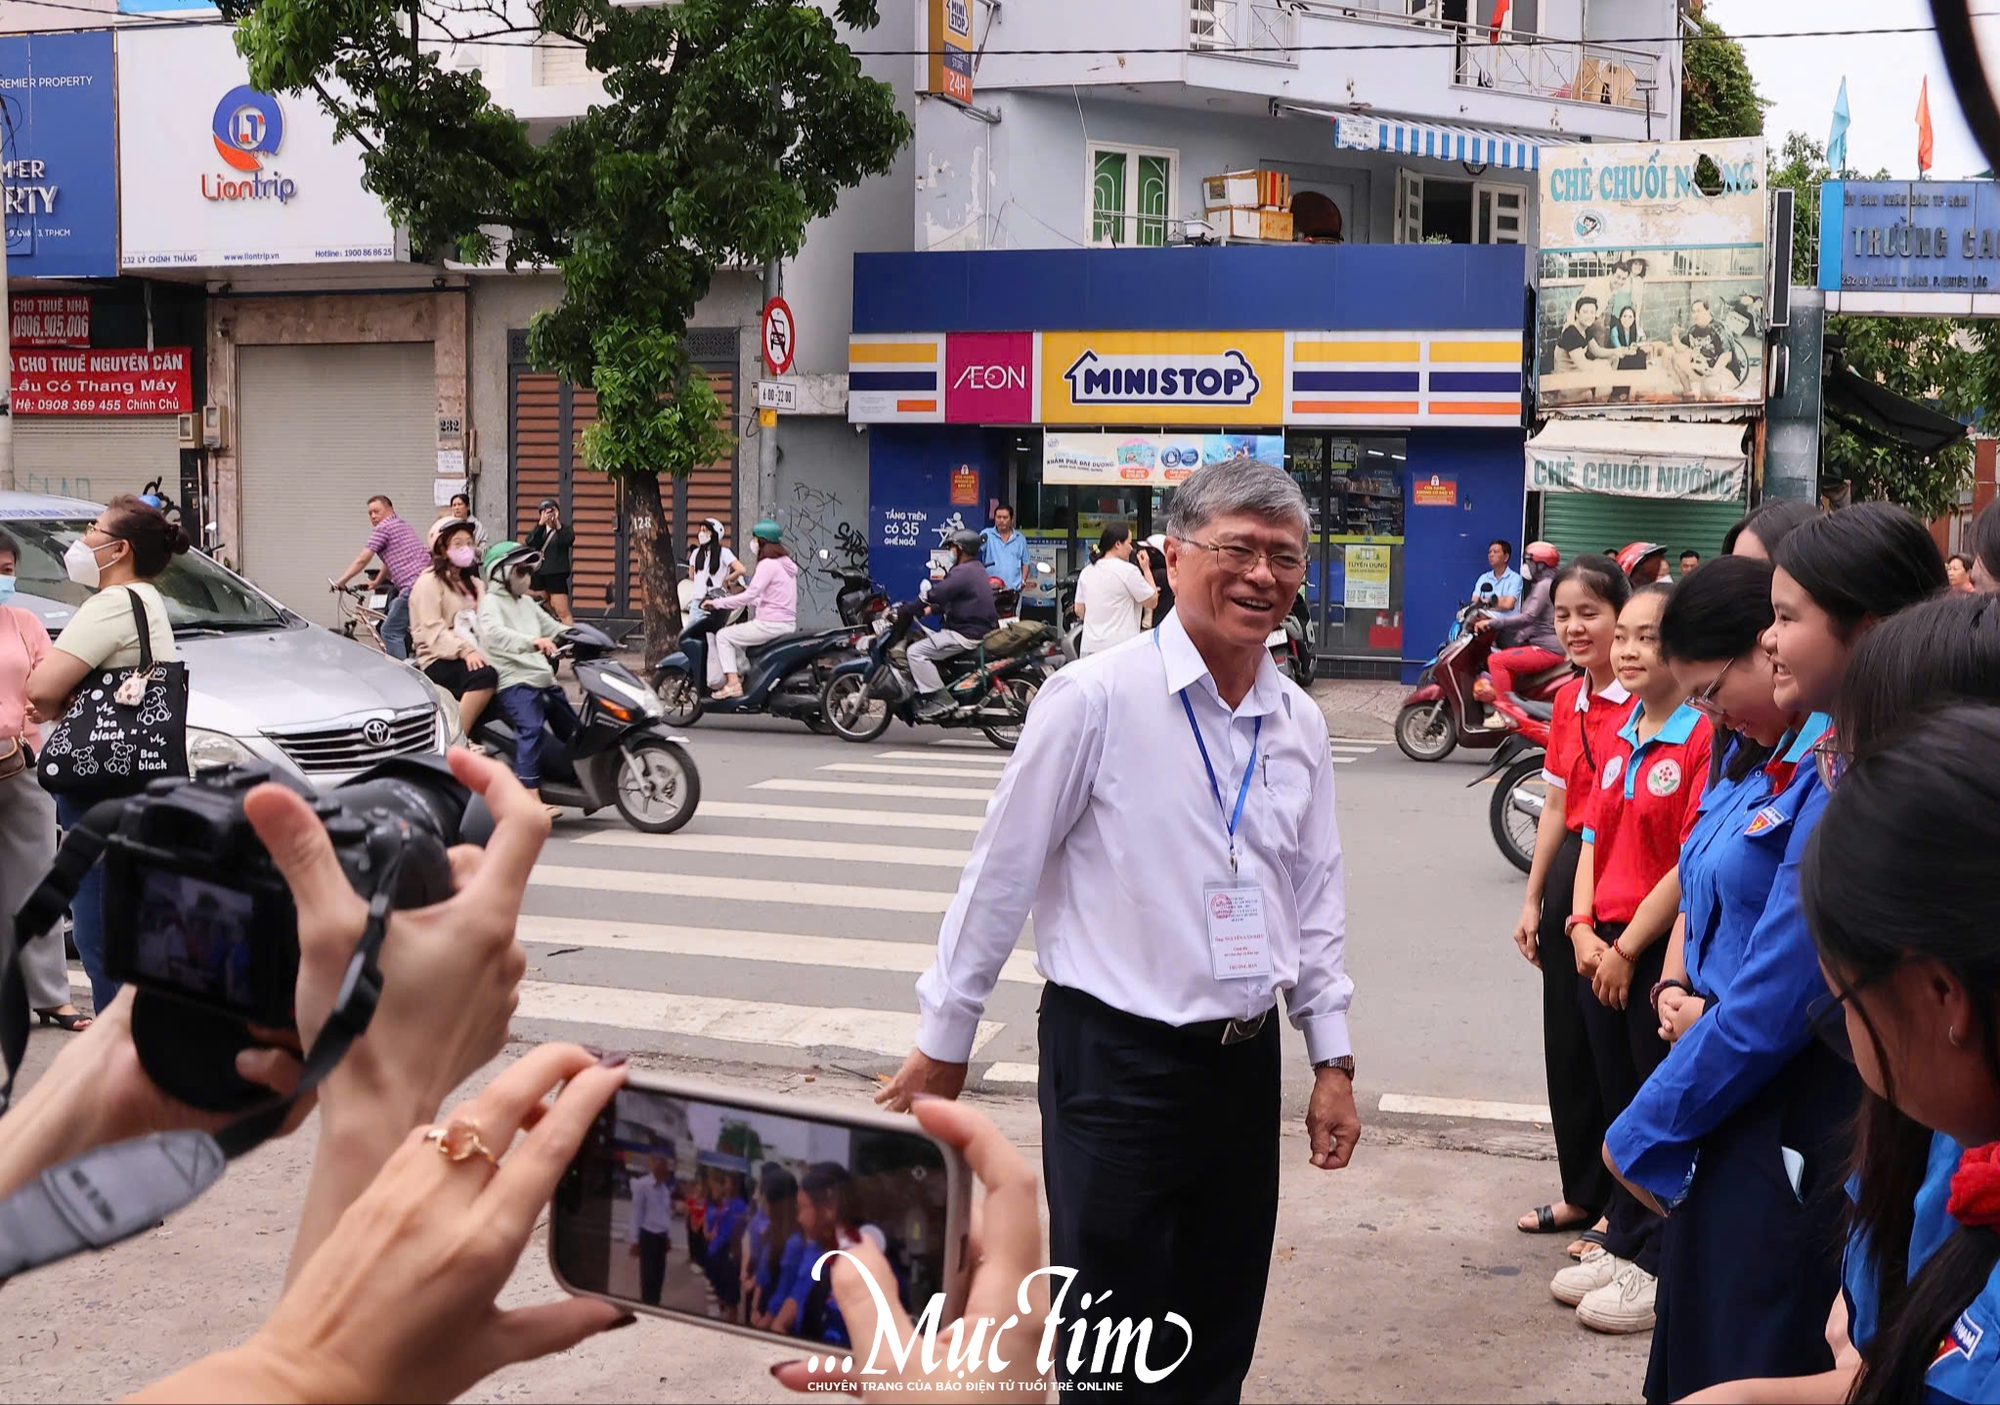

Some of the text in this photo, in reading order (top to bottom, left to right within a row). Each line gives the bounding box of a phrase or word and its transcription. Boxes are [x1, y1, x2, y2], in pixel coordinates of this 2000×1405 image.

[951, 14, 965, 30] STOP
[39, 75, 93, 87] PROPERTY
[950, 72, 967, 97] 24H
[1550, 157, 1593, 202] CHÈ
[1600, 149, 1667, 200] CHUỐI
[201, 171, 296, 204] Liontrip
[1853, 216, 2000, 259] TRƯỜNG CA
[137, 255, 145, 263] LÝ
[149, 254, 170, 263] CHÍNH
[224, 252, 280, 261] www.liontrip.vn
[344, 249, 362, 257] 1900
[363, 249, 372, 257] 86
[373, 249, 382, 257] 86
[383, 248, 392, 256] 25
[13, 297, 89, 312] CHO THUÊ NHÀ
[13, 315, 89, 338] 0906.905.006
[19, 357, 47, 372] CHO
[51, 353, 86, 372] THUÊ
[90, 354, 149, 372] NGUYÊN
[46, 379, 71, 392] Có
[76, 380, 134, 394] Thang
[140, 379, 177, 393] Máy
[1084, 368, 1245, 395] MINISTOP
[15, 396, 179, 412] Hệ: 0908 369 455 Chính Chủ
[440, 419, 459, 432] 232
[1534, 456, 1576, 487] CHÈ
[885, 508, 927, 521] TẦNG TRÊN
[633, 516, 652, 530] 128
[901, 521, 920, 536] 35
[89, 728, 125, 742] black
[140, 749, 159, 759] Bea
[138, 759, 168, 771] black
